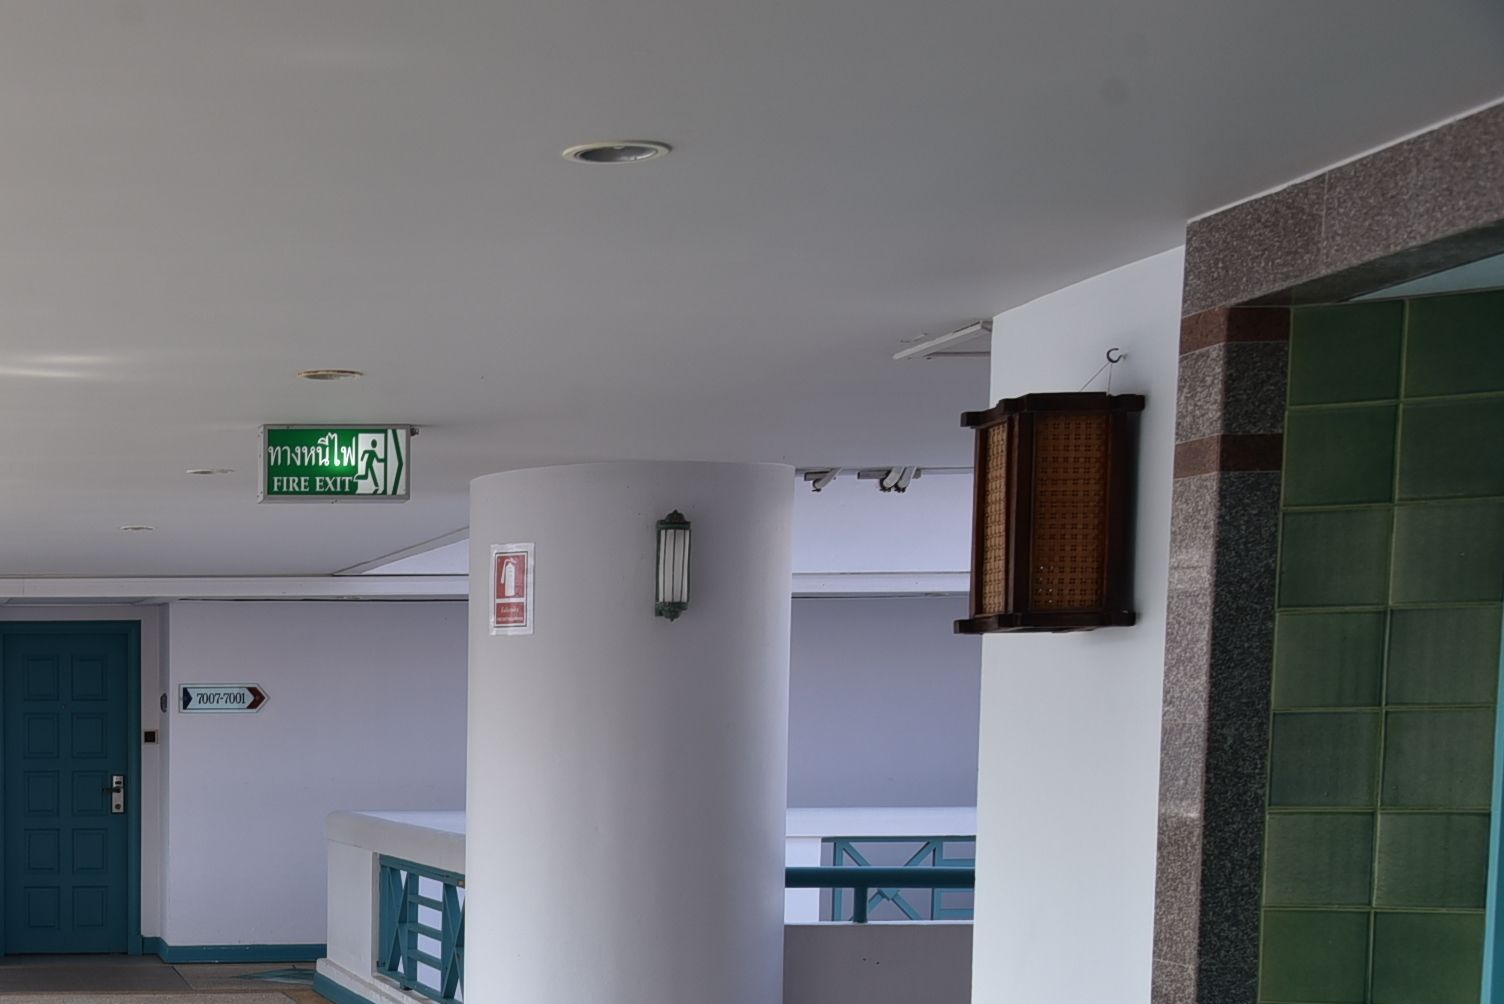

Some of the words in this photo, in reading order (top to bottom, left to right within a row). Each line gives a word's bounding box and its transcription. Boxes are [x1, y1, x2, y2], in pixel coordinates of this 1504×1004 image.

[268, 432, 356, 467] ทางหนีไฟ
[272, 476, 310, 492] FIRE
[315, 476, 353, 492] EXIT
[196, 692, 246, 705] 7007-7001
